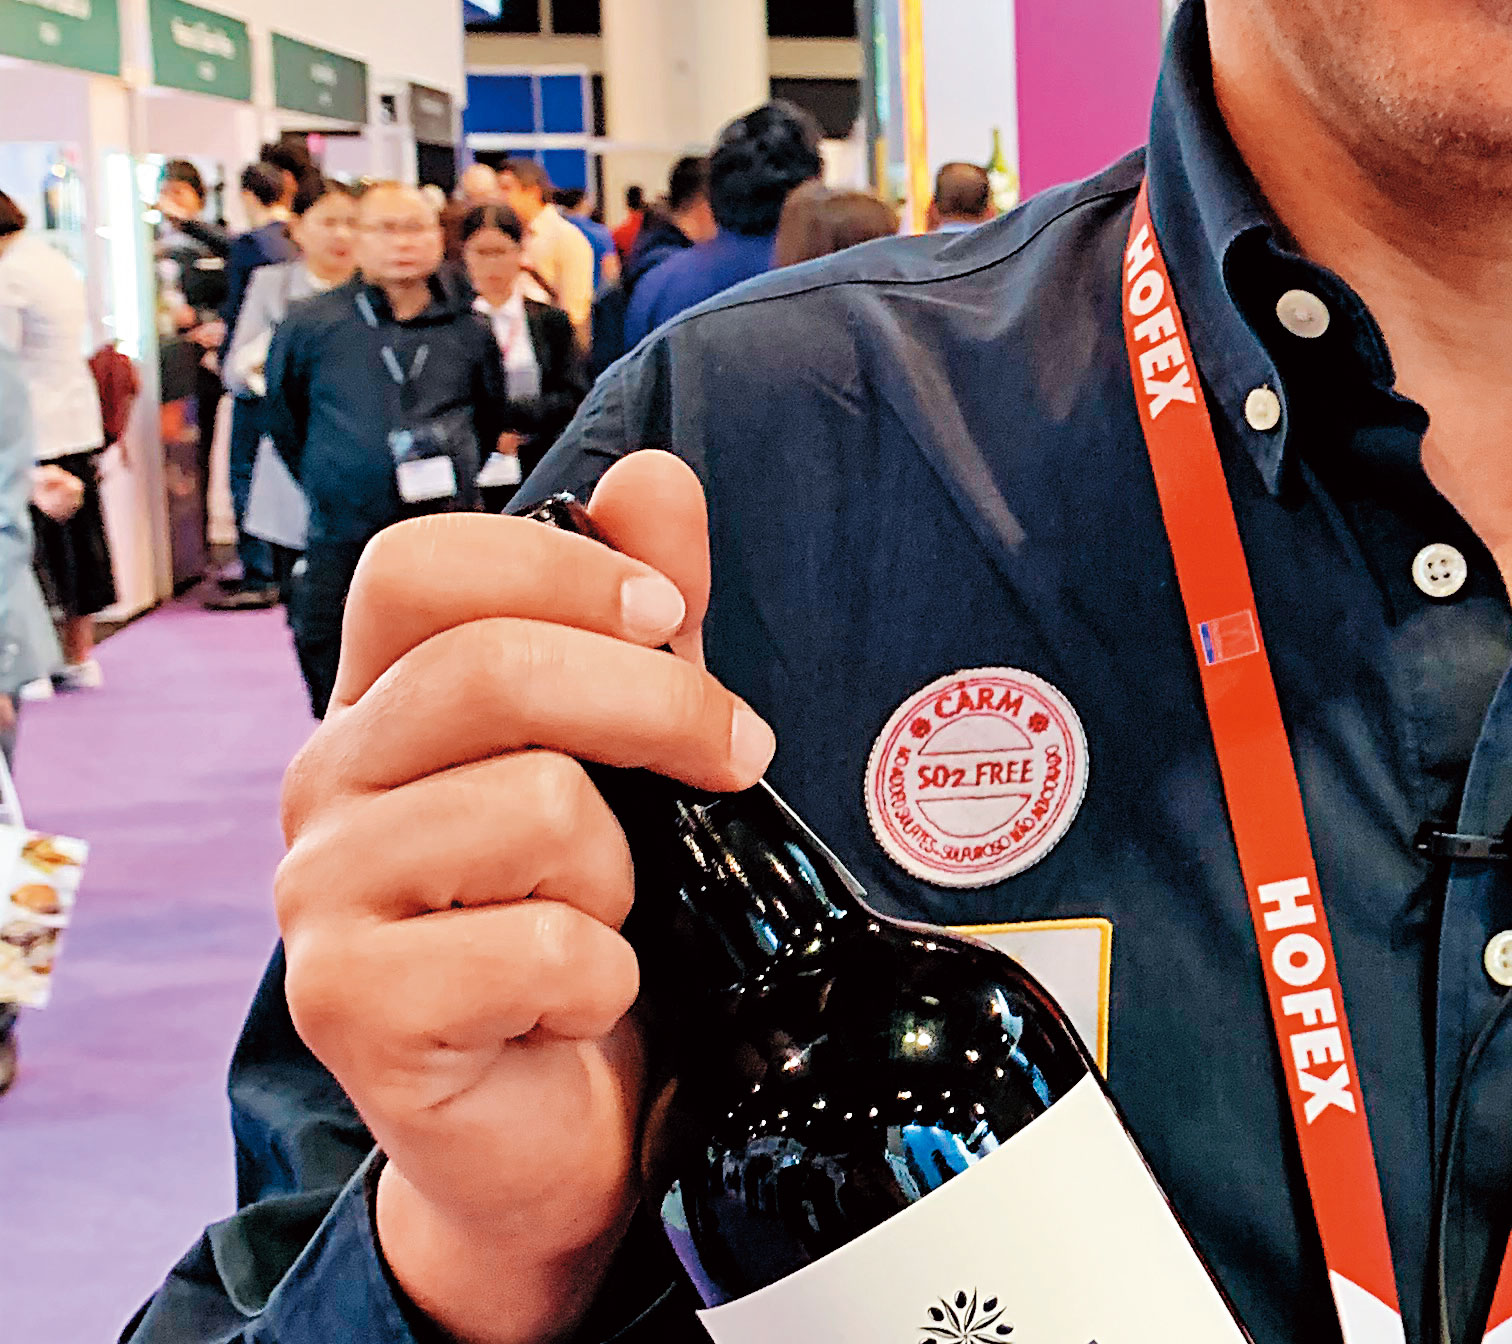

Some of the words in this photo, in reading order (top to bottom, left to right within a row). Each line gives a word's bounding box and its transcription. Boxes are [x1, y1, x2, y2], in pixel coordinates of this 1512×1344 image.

[1127, 224, 1197, 420] HOFEX
[934, 687, 1024, 718] CARM
[976, 759, 1034, 786] FREE
[1257, 876, 1357, 1125] HOFEX
